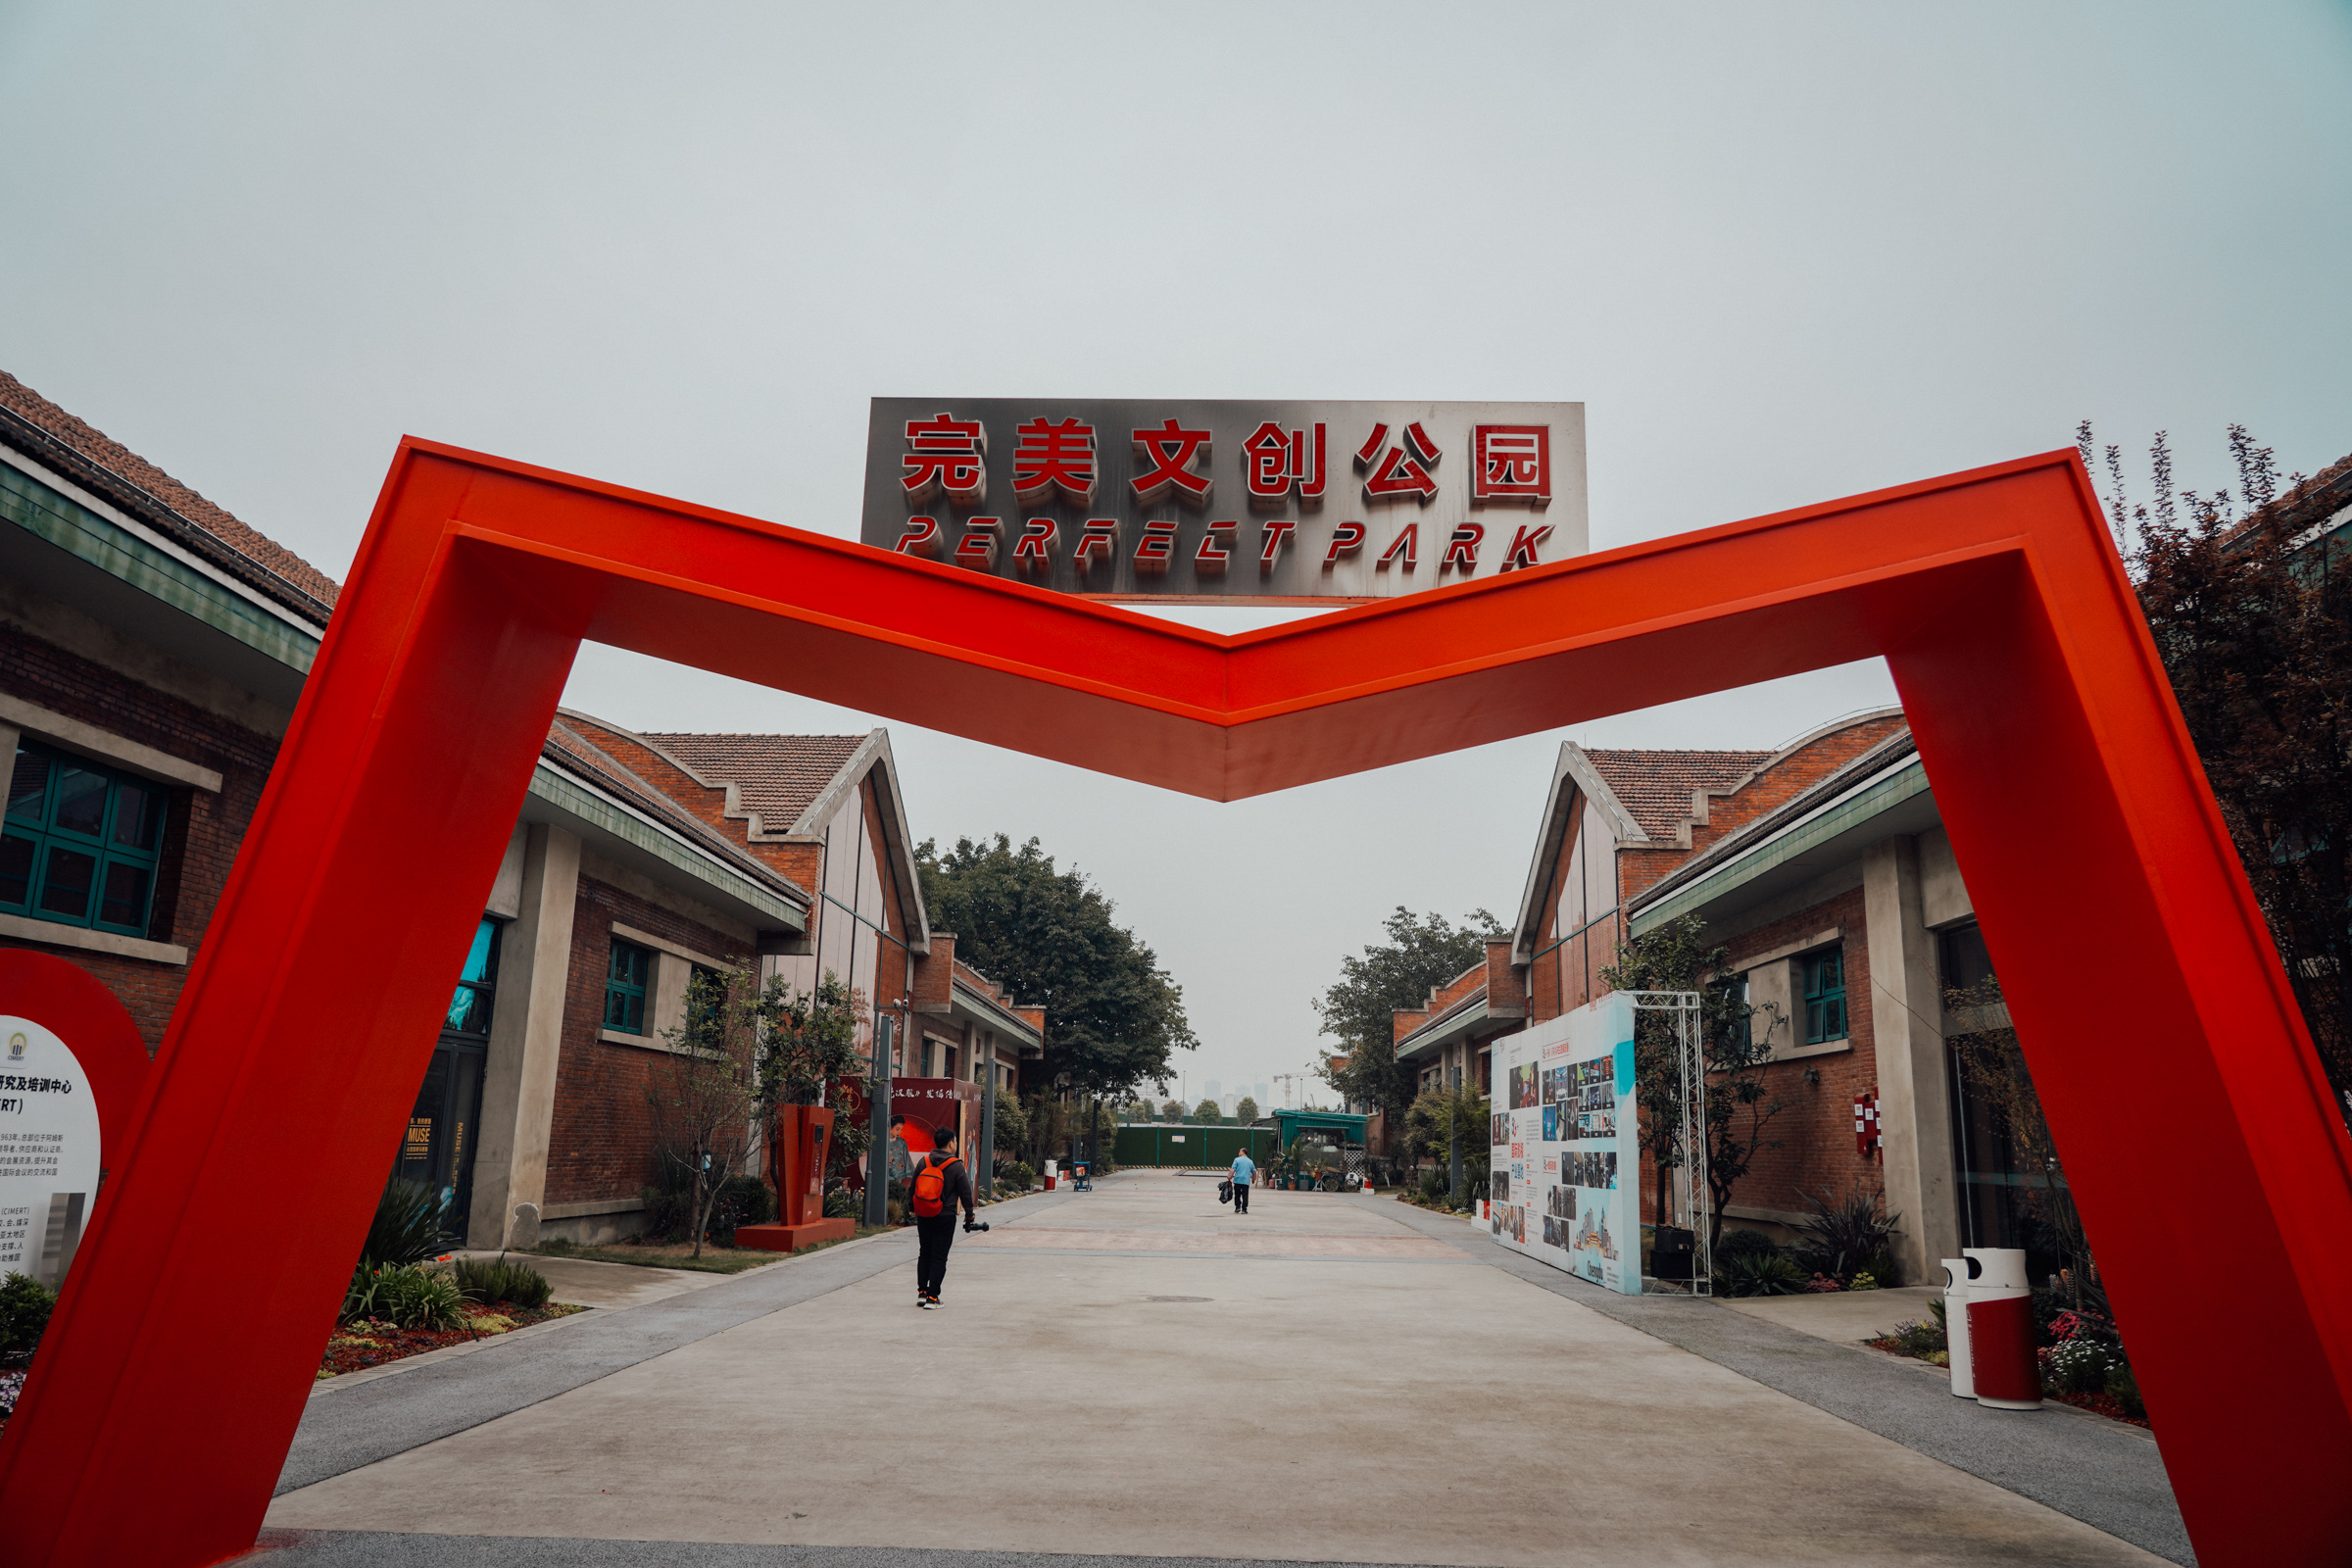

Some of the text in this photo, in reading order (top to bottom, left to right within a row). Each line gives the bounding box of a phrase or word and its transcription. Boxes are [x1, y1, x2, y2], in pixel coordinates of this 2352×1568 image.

[898, 412, 1552, 507] 完美文创公园
[895, 515, 1556, 572] PERFECT PARK
[0, 1098, 24, 1115] RT)
[408, 1128, 431, 1143] MUSE
[455, 1122, 464, 1152] MUSE
[1, 1206, 30, 1215] (CIMERT)
[1587, 1259, 1603, 1283] Chengdu
